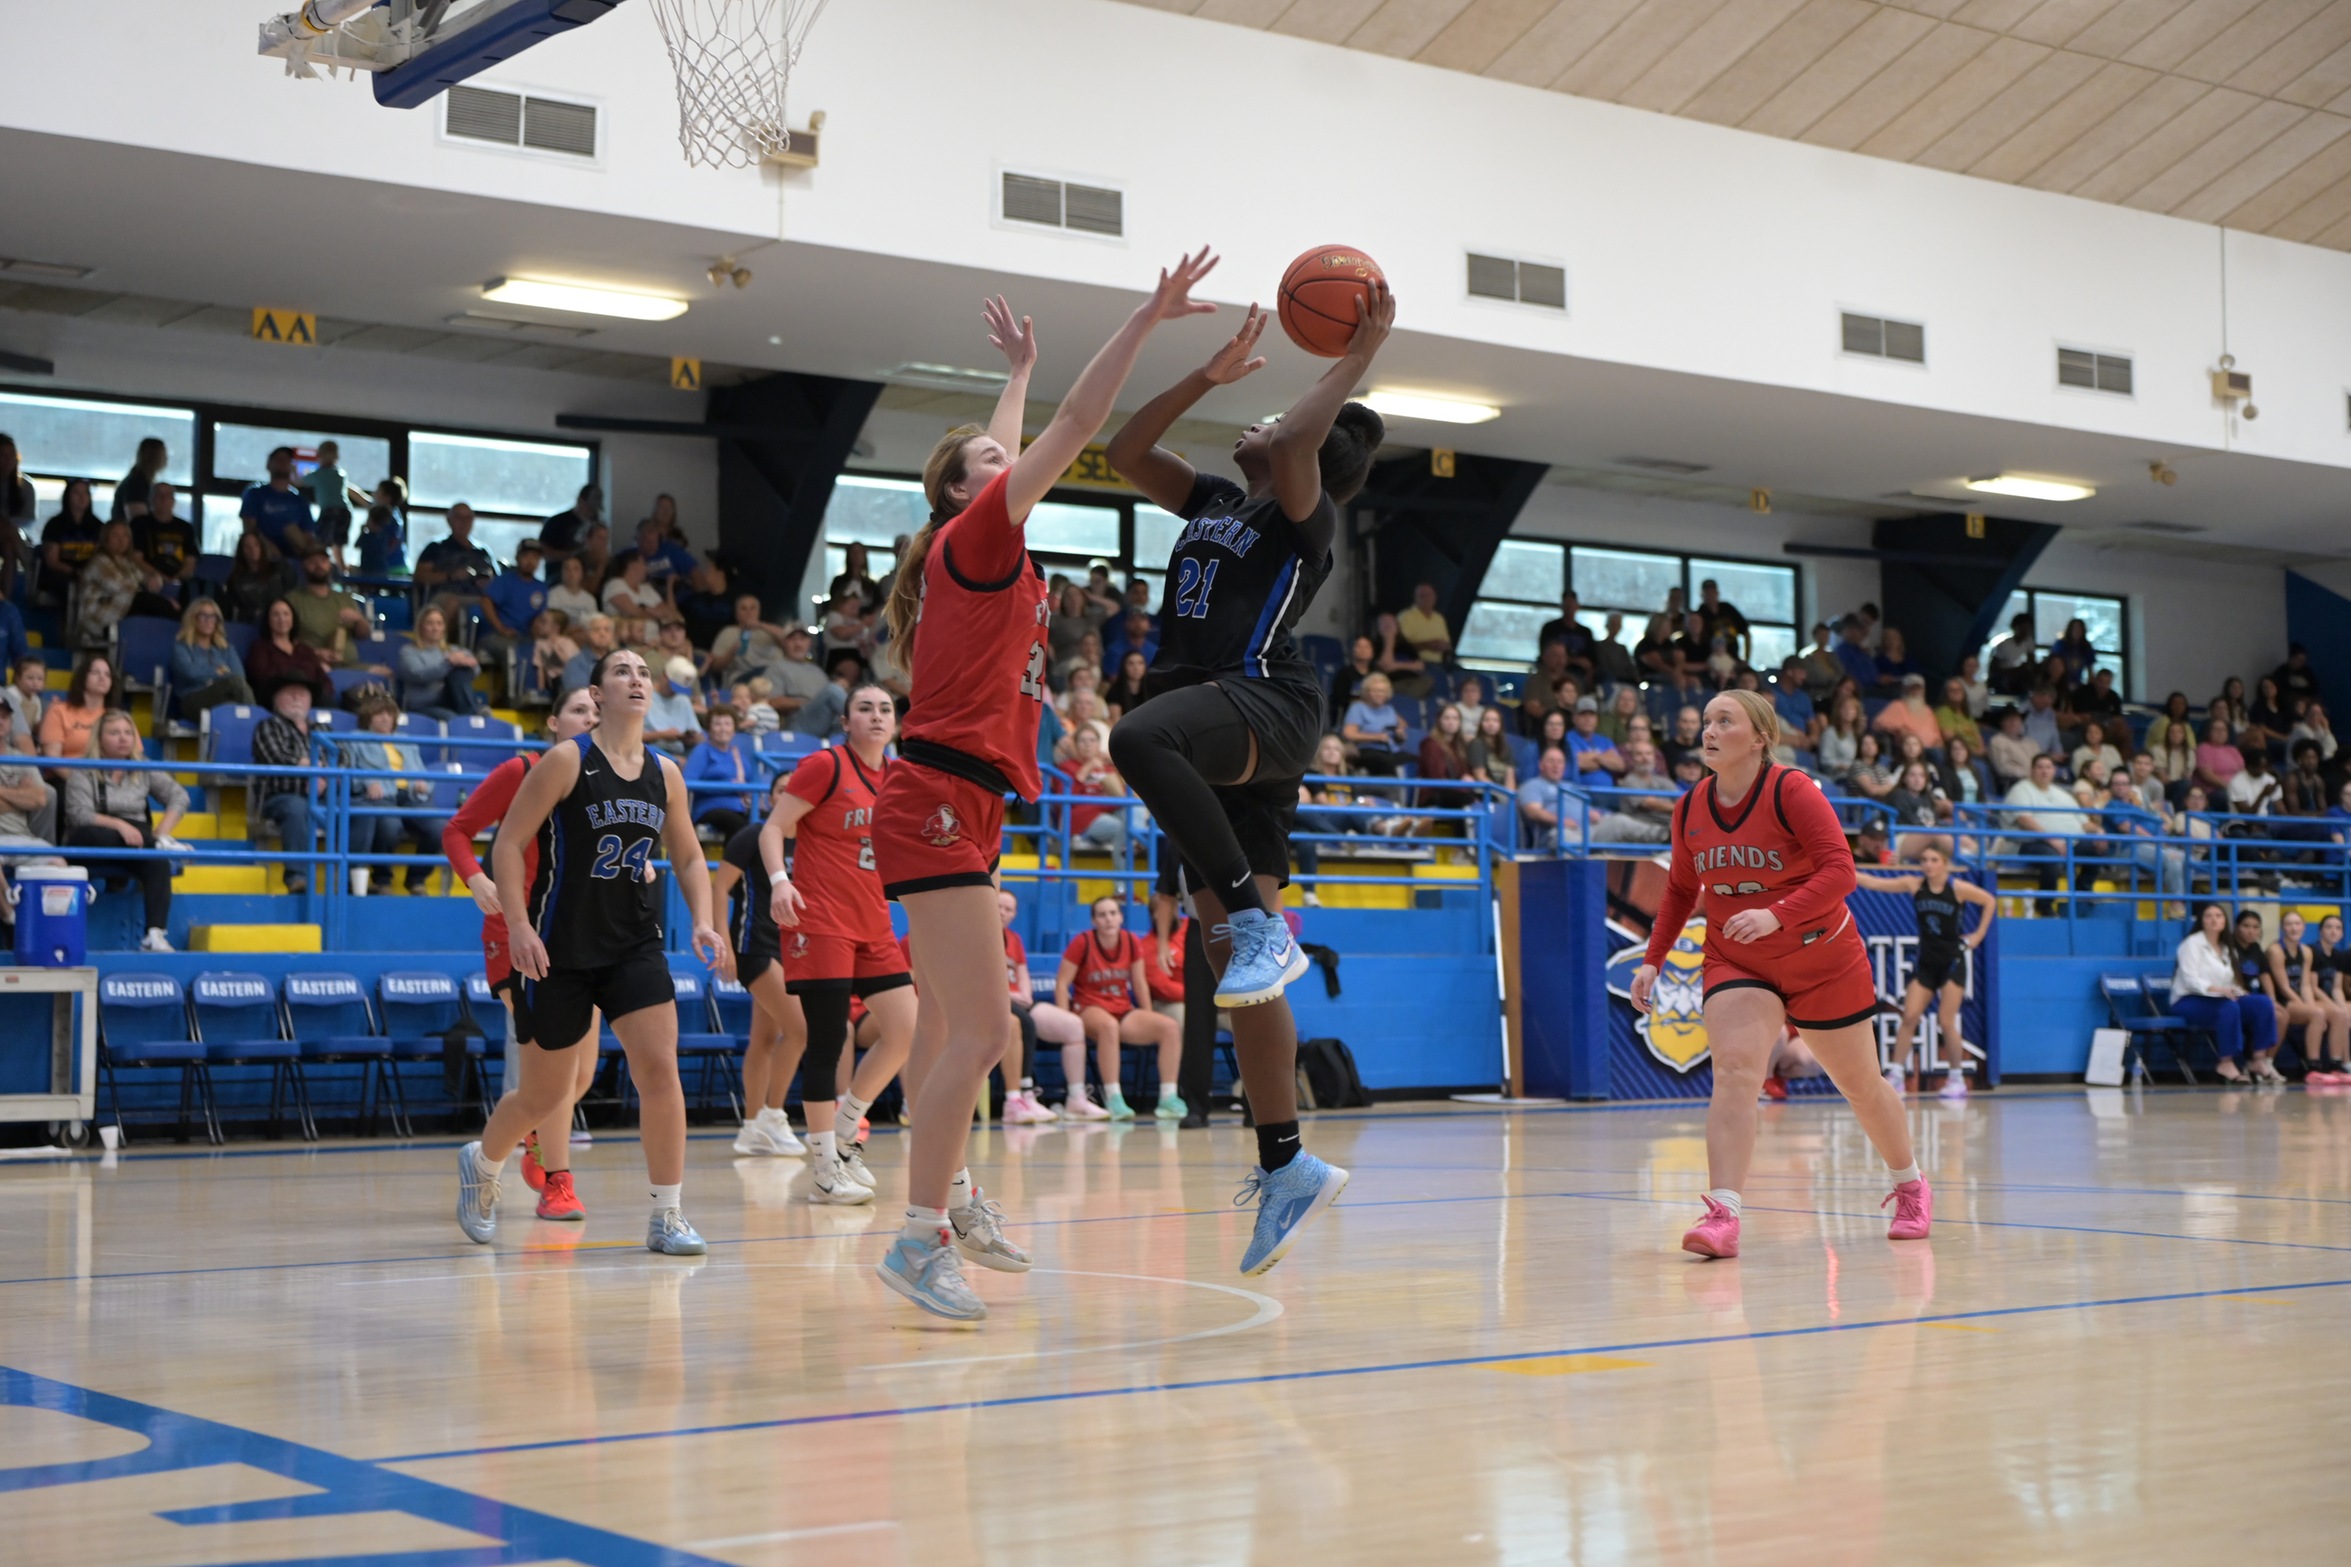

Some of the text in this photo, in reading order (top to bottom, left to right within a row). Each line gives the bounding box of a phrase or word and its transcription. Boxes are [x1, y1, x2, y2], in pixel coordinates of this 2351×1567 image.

[675, 360, 698, 387] A
[1176, 557, 1220, 619] 21
[590, 834, 654, 883] 24
[106, 980, 175, 998] EASTERN
[201, 980, 266, 998] EASTERN
[291, 979, 358, 995] EASTERN
[387, 978, 452, 994] EASTERN
